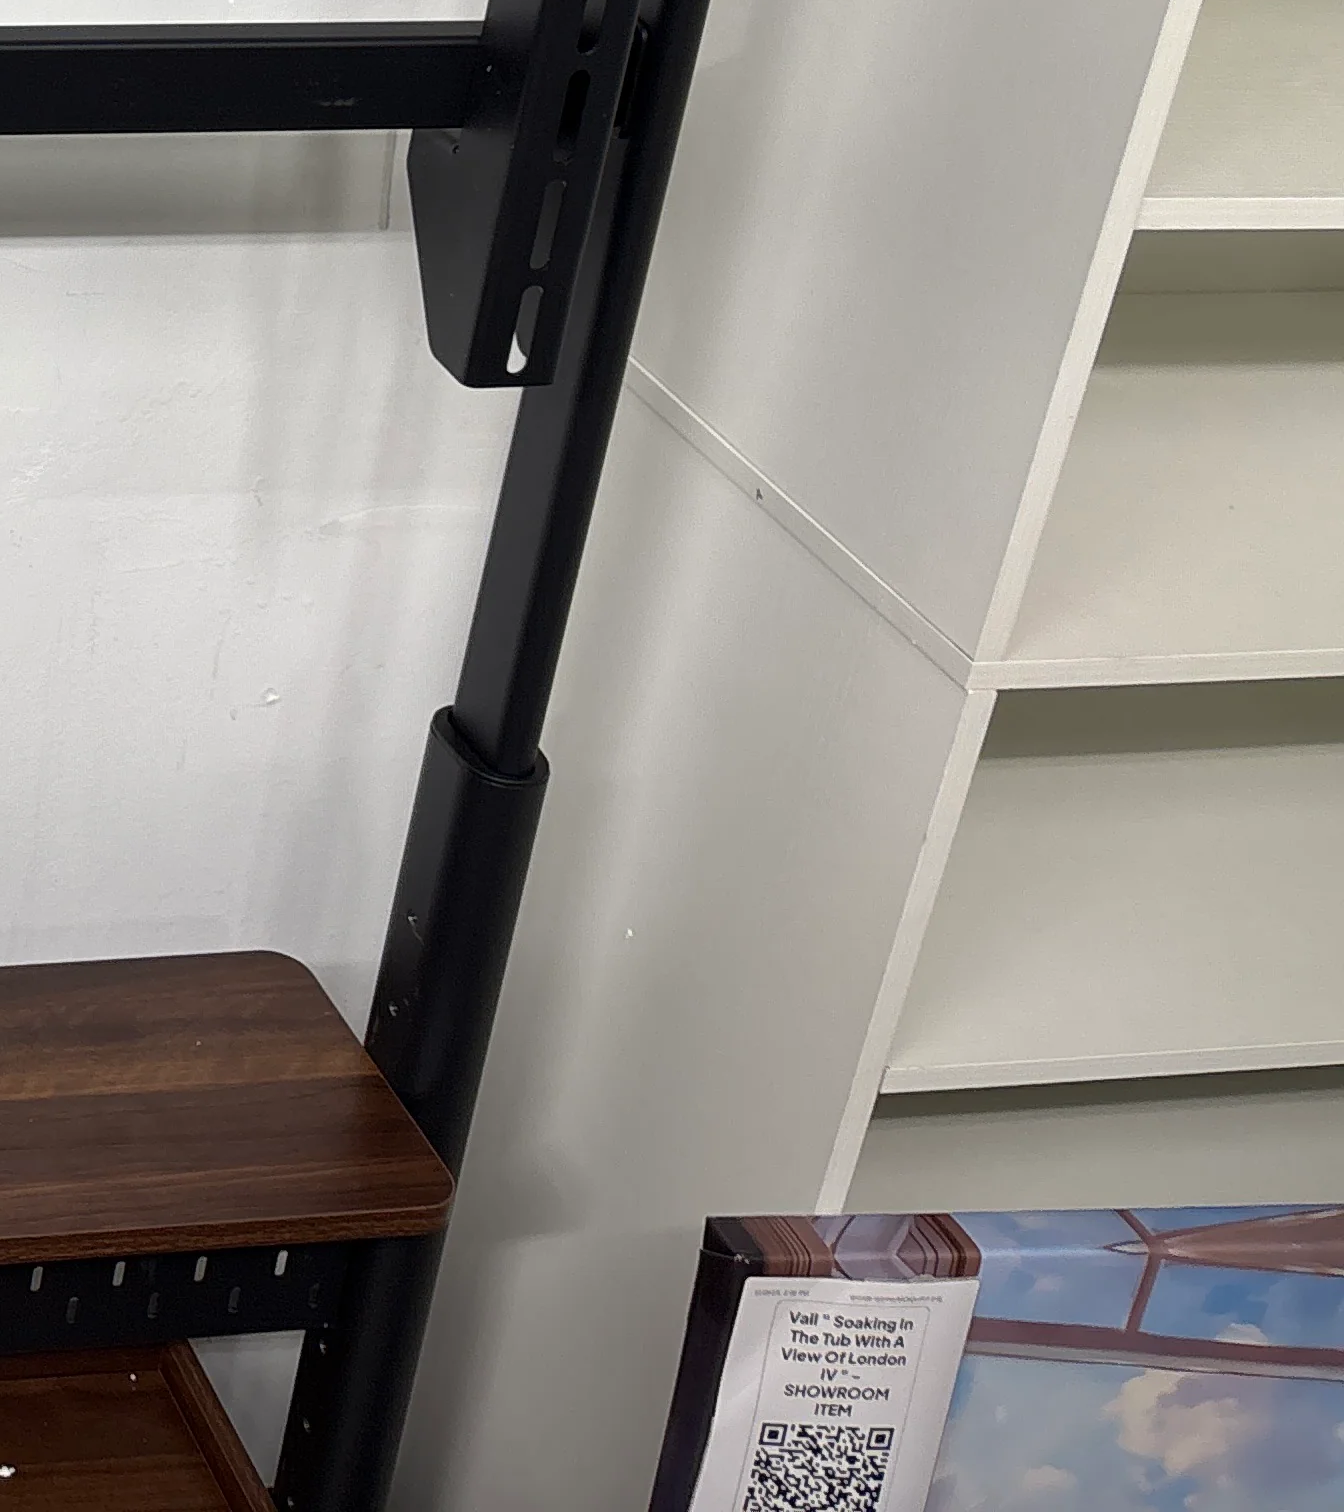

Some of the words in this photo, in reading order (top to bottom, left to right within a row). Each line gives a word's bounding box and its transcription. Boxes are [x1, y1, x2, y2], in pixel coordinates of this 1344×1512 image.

[789, 1310, 819, 1327] Vail
[832, 1314, 897, 1333] Soaking
[900, 1317, 914, 1331] In
[790, 1329, 819, 1345] The
[822, 1332, 851, 1347] Tub
[854, 1334, 891, 1348] With
[893, 1336, 905, 1348] A
[781, 1347, 823, 1362] View
[825, 1350, 846, 1364] Of
[848, 1352, 907, 1366] London
[820, 1368, 838, 1381] IV
[783, 1383, 890, 1401] SHOWROOM
[814, 1402, 853, 1417] ITEM
